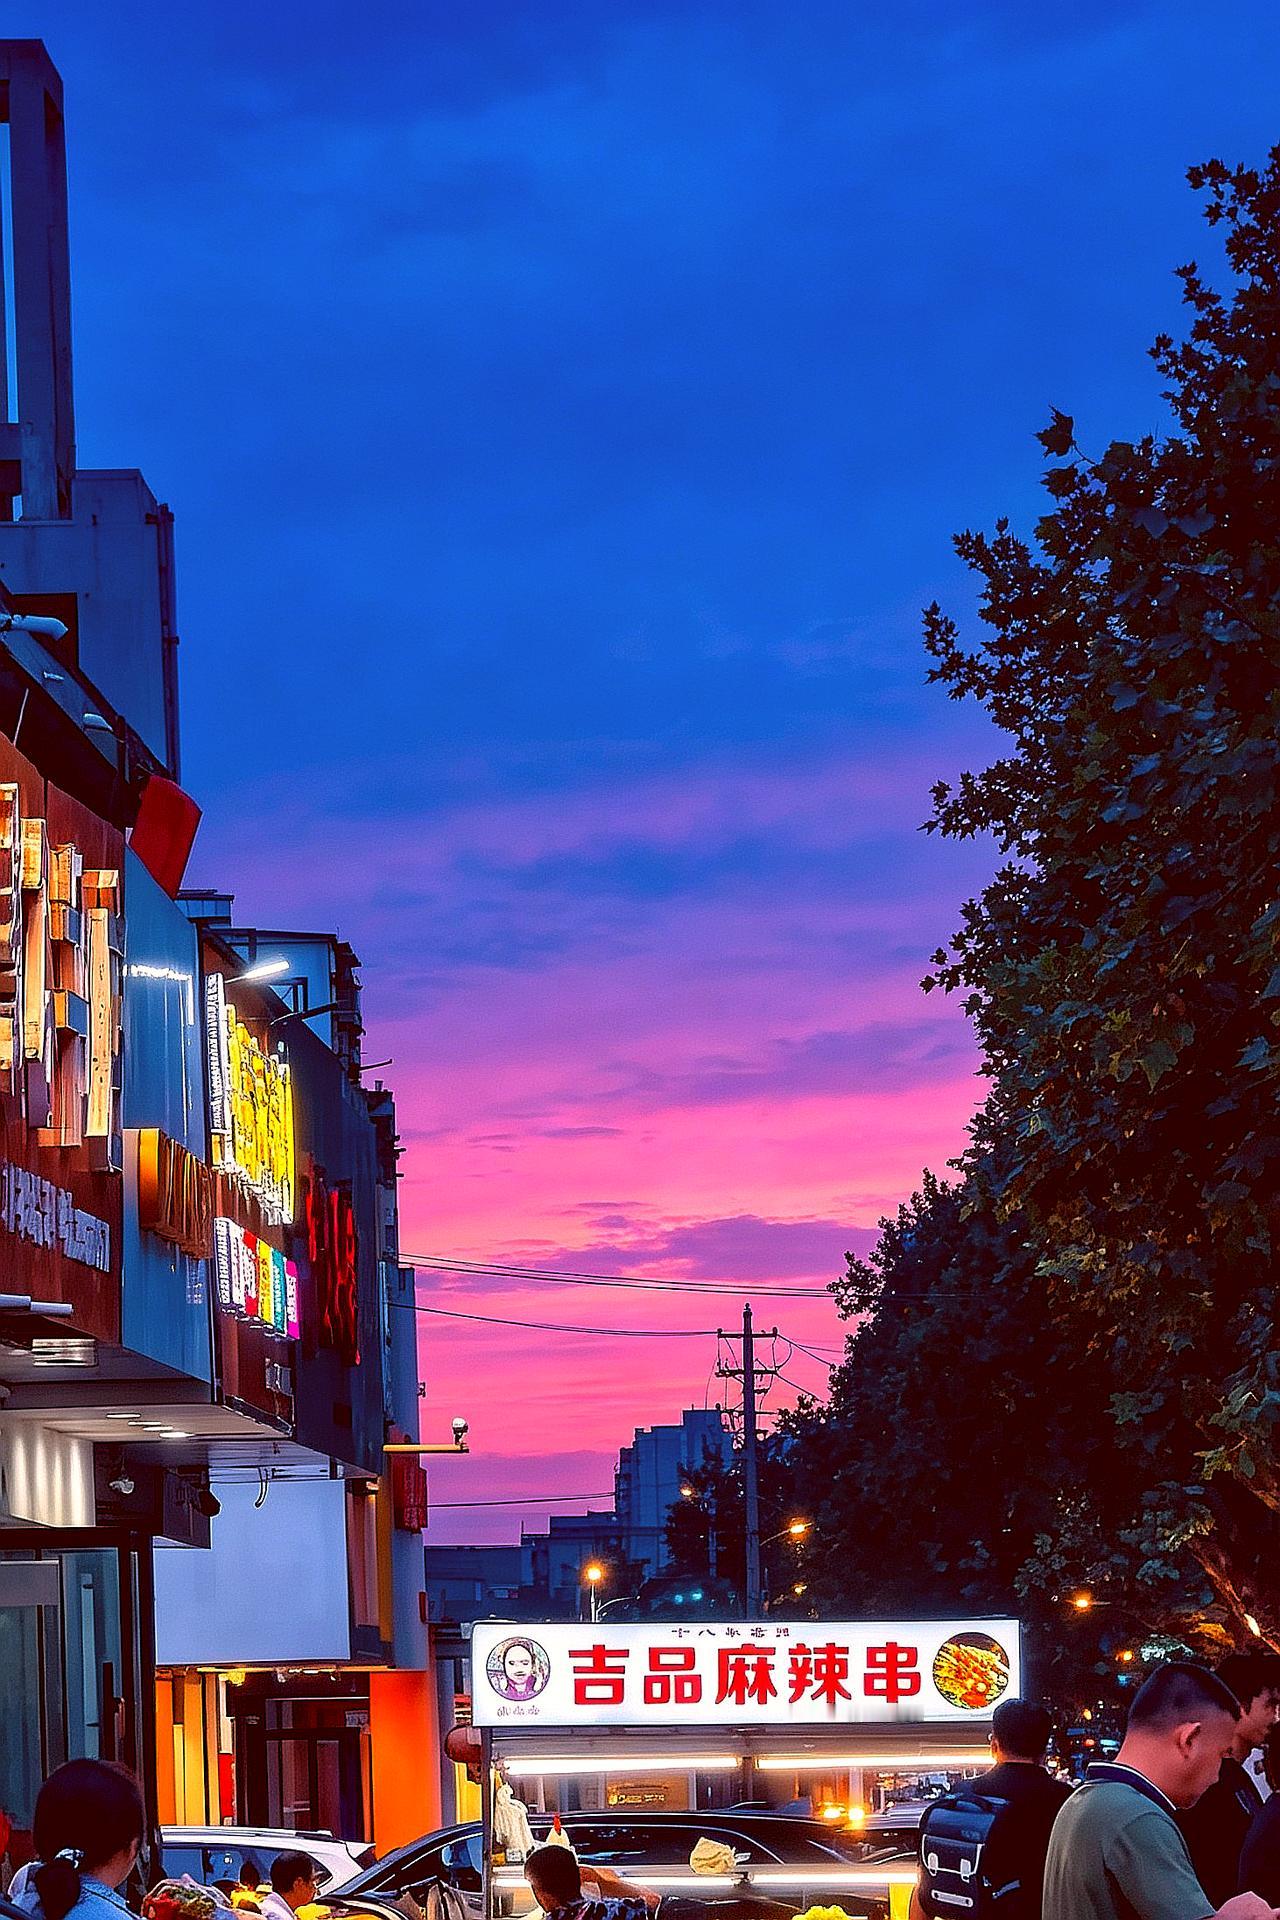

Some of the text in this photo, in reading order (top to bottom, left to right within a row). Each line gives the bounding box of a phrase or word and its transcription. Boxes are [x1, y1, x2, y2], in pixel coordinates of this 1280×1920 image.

[568, 1641, 921, 1704] 吉品麻辣串
